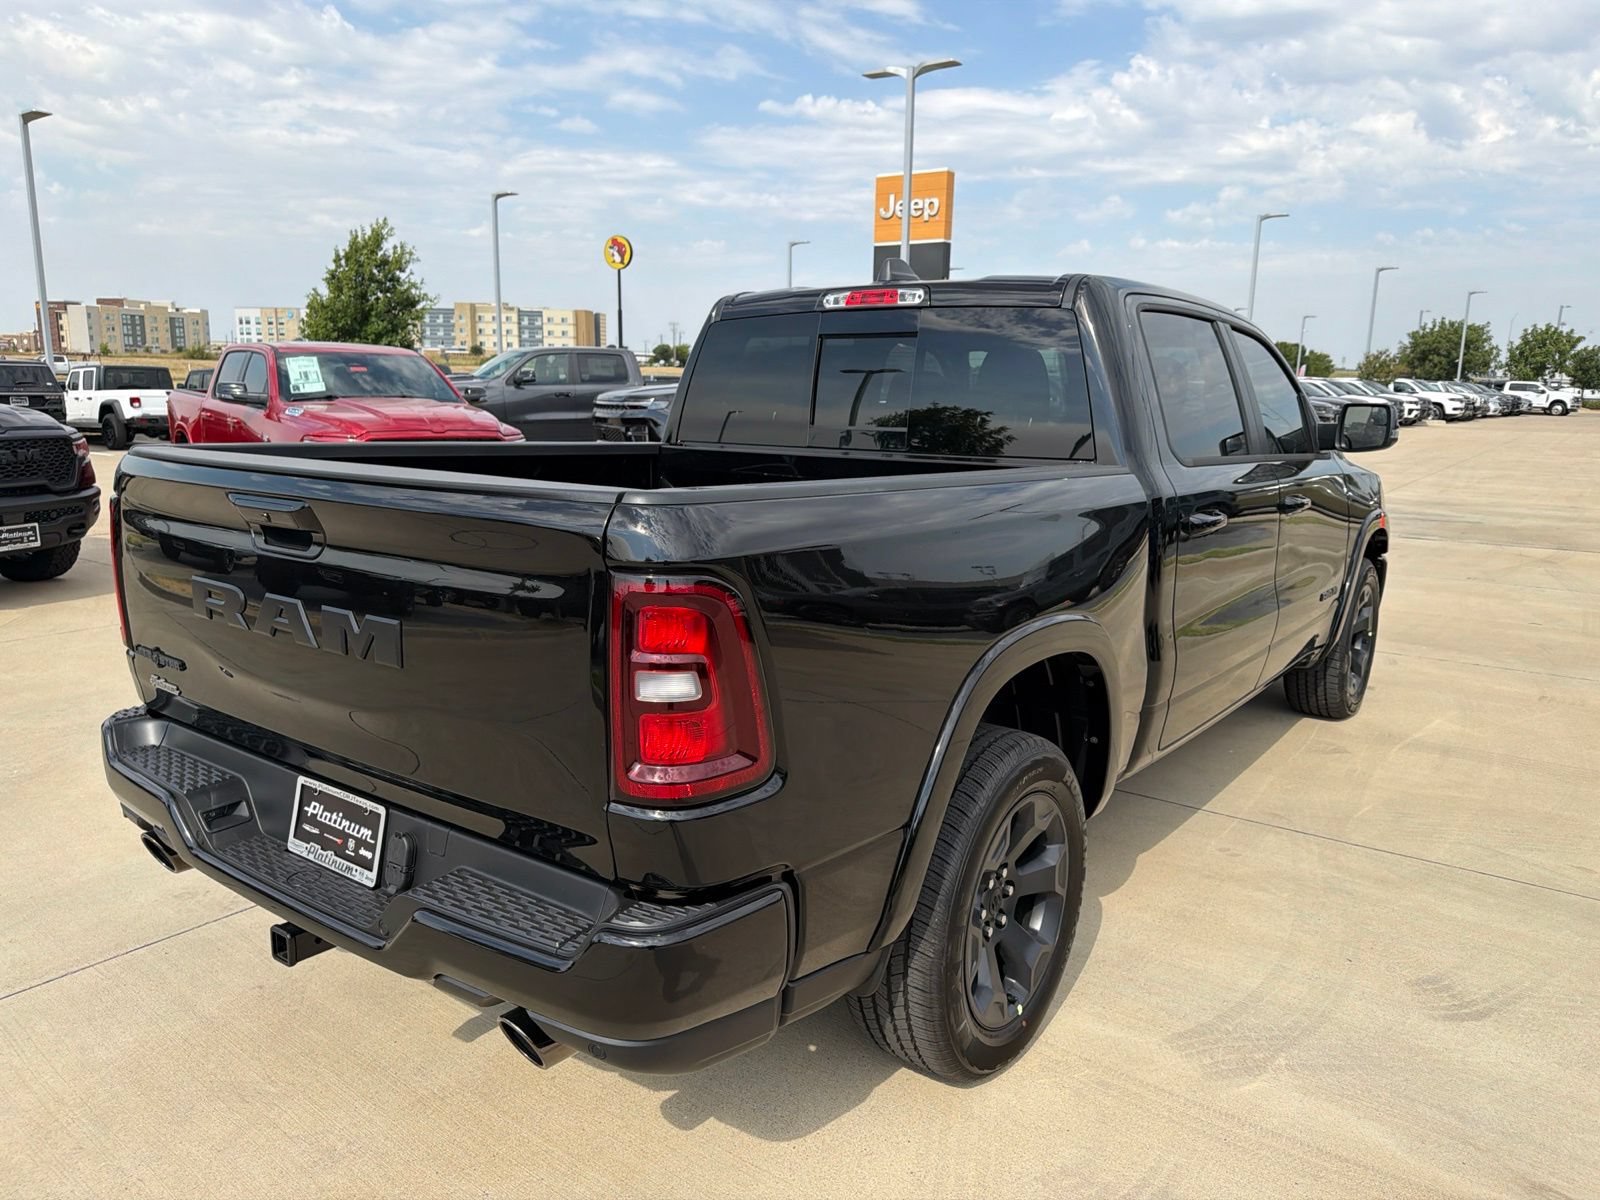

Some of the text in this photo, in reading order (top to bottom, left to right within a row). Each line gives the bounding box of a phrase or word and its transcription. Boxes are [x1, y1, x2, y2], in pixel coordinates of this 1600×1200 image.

[879, 193, 940, 222] Jeep
[192, 575, 404, 669] RAM
[303, 801, 376, 844] Platinum
[307, 844, 357, 877] Platinum
